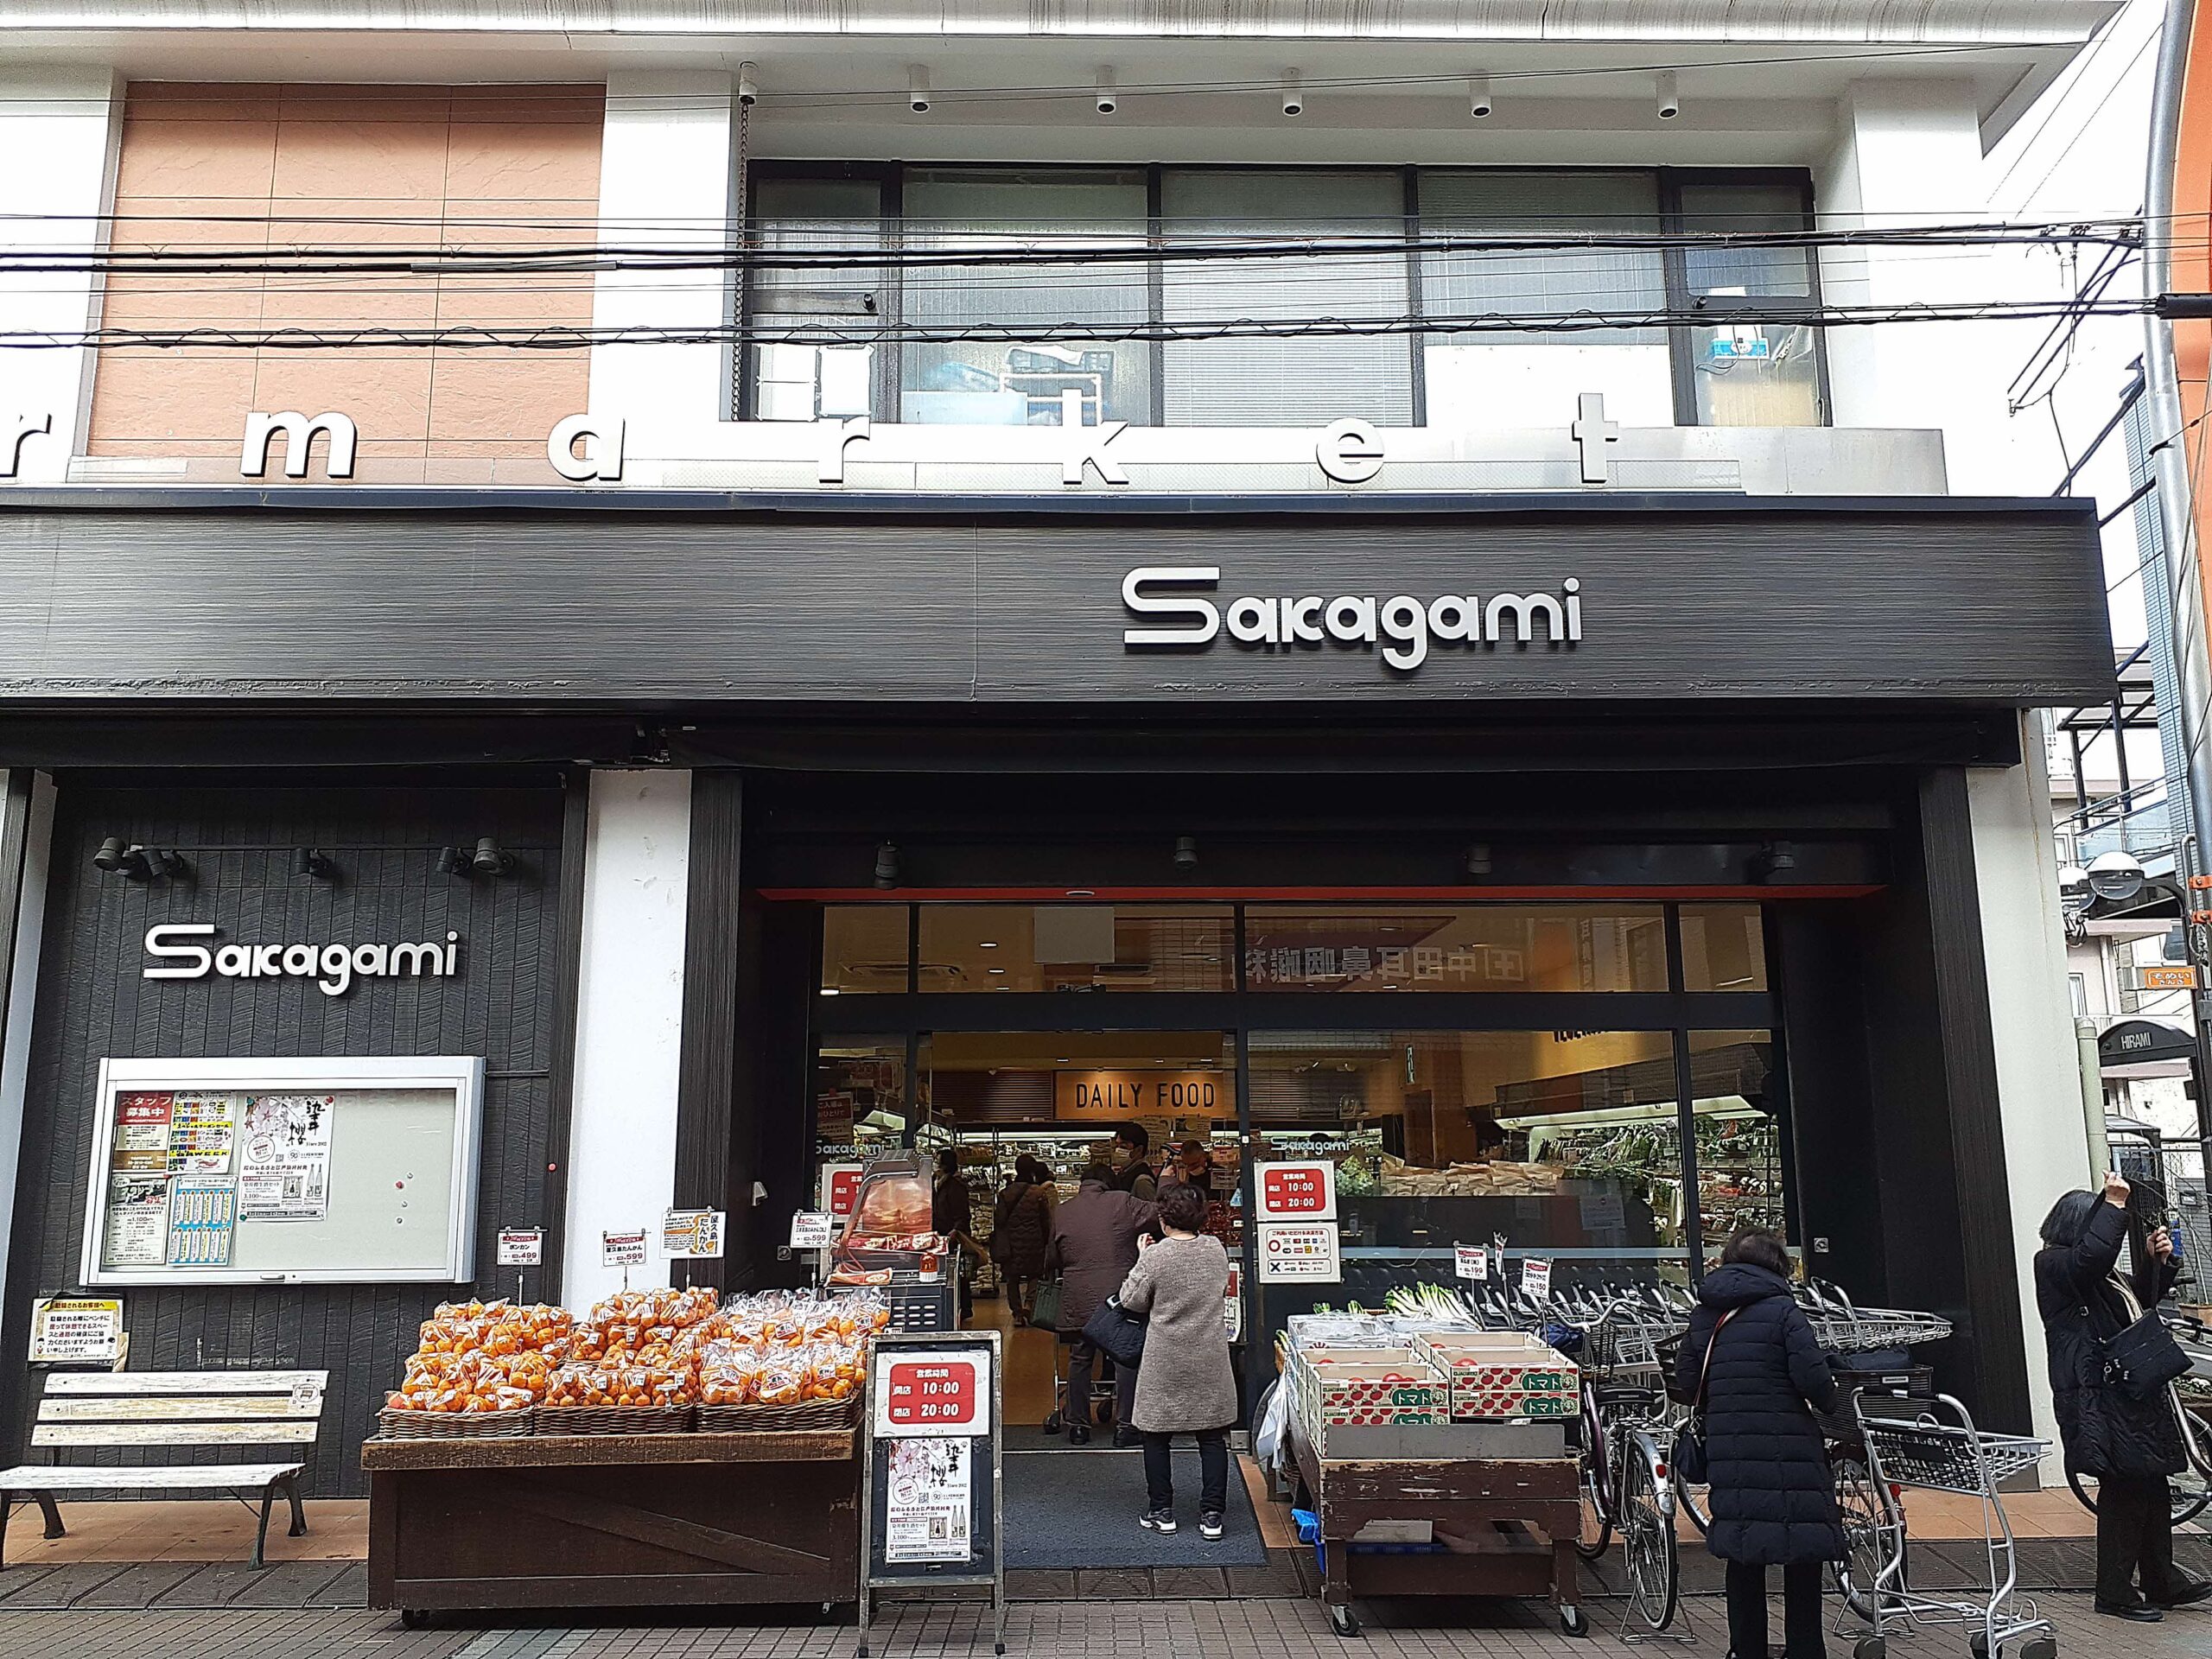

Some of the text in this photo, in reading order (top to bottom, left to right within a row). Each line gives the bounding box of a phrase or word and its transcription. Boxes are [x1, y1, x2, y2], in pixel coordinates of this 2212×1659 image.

[1122, 567, 1583, 671] Sakagami
[143, 924, 458, 996] Sakagami
[2120, 1032, 2152, 1050] HIRAMI
[1076, 1082, 1215, 1109] DAILY FOOD
[1288, 1183, 1313, 1192] 10:00
[1287, 1198, 1315, 1207] 20:00
[922, 1382, 960, 1395] 10:00
[1529, 1377, 1559, 1389] トマト
[1398, 1392, 1430, 1405] トマト
[920, 1403, 959, 1417] 20:00
[1529, 1402, 1560, 1414] トマト
